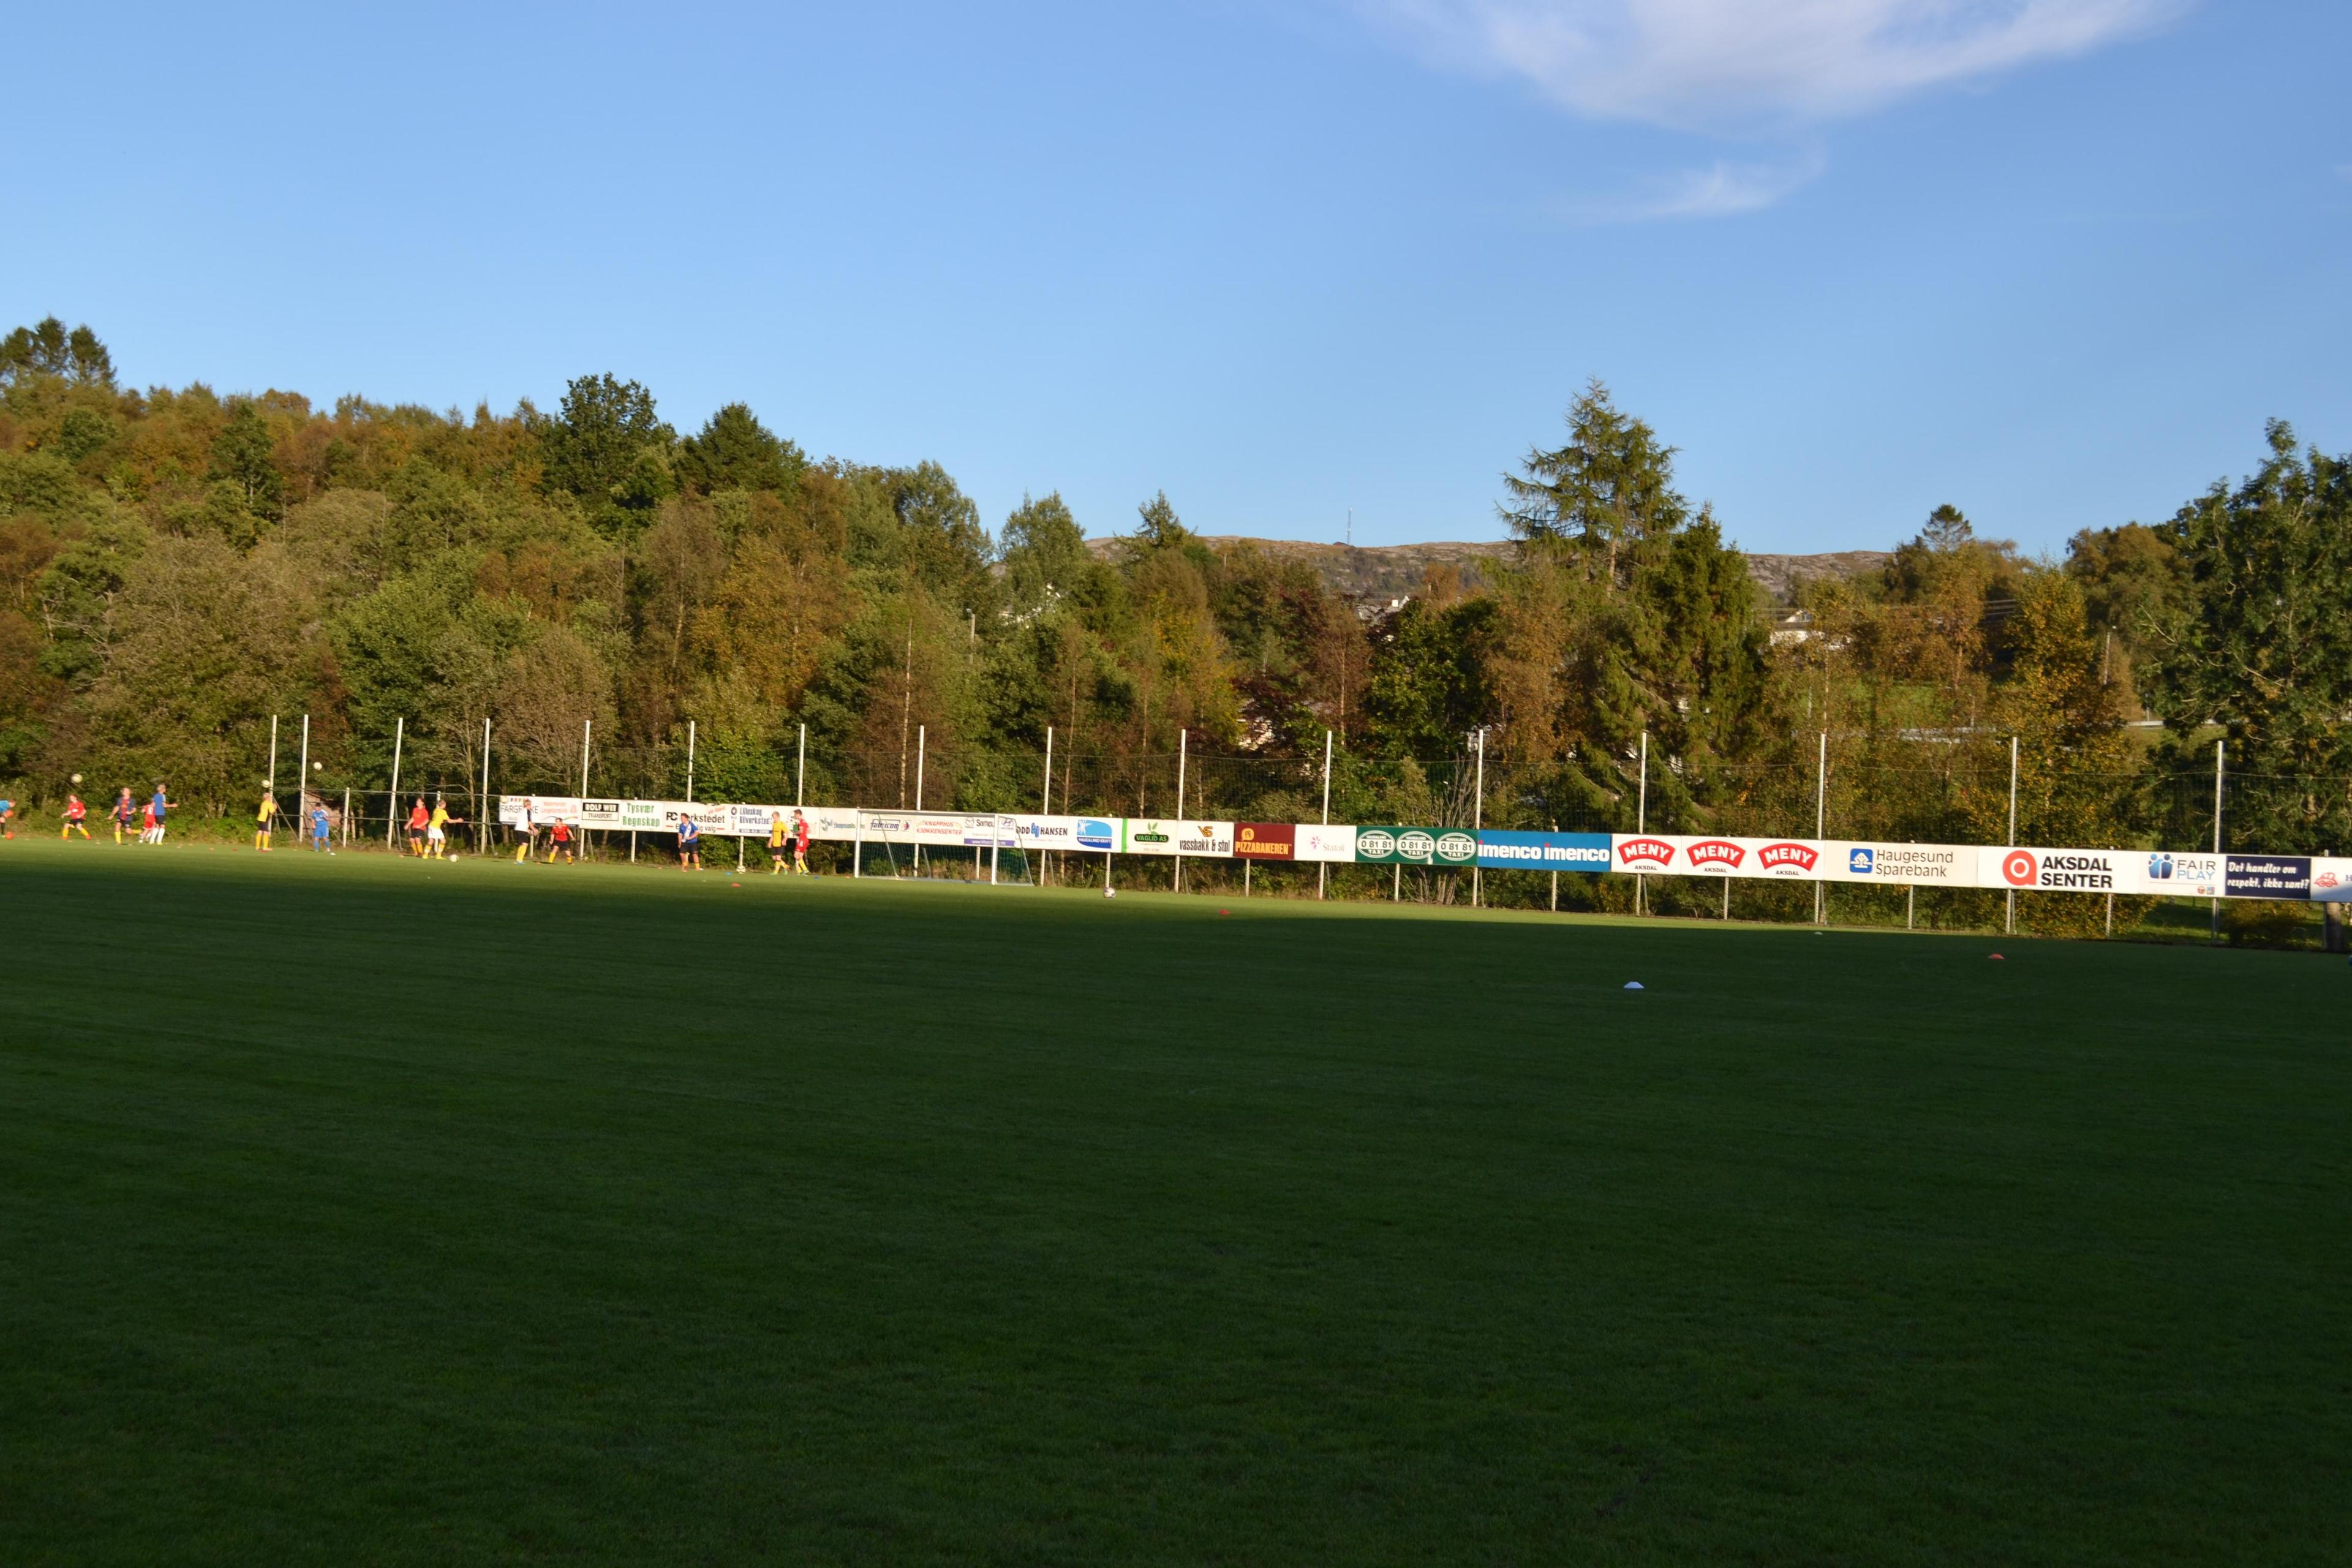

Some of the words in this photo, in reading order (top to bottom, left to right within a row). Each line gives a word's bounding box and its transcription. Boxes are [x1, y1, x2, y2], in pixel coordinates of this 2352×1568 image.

[627, 803, 654, 814] Tysvær
[622, 816, 660, 827] Regnskap
[1040, 826, 1068, 835] HANSEN
[1180, 839, 1209, 851] vassbakk
[1212, 840, 1216, 851] &
[1218, 840, 1230, 852] stol
[1235, 841, 1289, 854] PIZZABAKEREN
[1322, 843, 1344, 852] Statoil
[1477, 840, 1542, 859] imenco
[1544, 842, 1610, 862] imenco
[1624, 843, 1670, 859] MENY
[1693, 845, 1740, 861] MENY
[1764, 847, 1813, 864] MENY
[1877, 849, 1953, 864] Haugesund
[1876, 863, 1947, 877] Sparebank
[2041, 856, 2113, 872] AKSDAL
[2177, 859, 2216, 870] FAIR
[2228, 862, 2244, 872] Det
[2245, 862, 2281, 873] handler
[2041, 872, 2113, 888] SENTER
[2177, 870, 2215, 880] PLAY
[2227, 877, 2261, 889] respekt,
[2263, 878, 2283, 889] ikke
[2284, 878, 2310, 889] sant?
